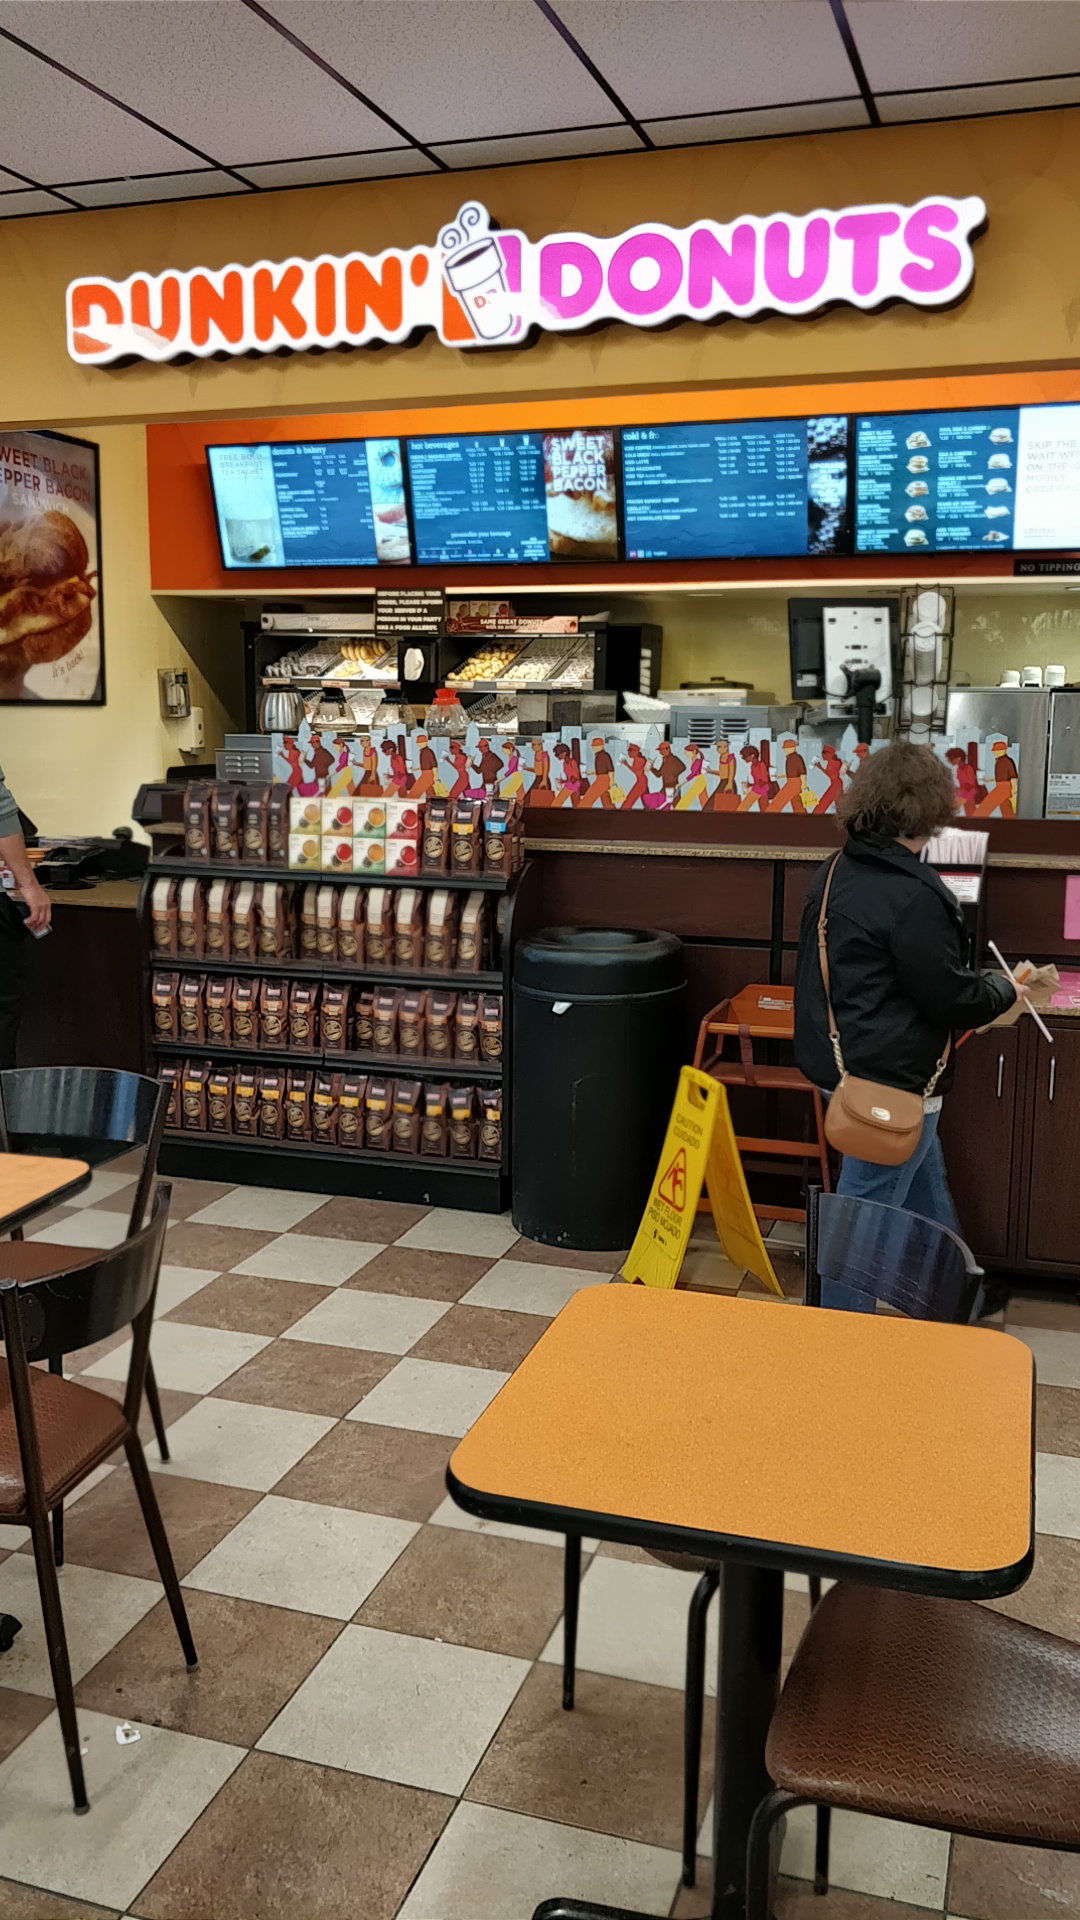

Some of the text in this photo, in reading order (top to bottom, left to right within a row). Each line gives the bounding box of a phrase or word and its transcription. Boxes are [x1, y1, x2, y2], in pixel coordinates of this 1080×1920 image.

[72, 203, 962, 354] DUNKIN' DONUTS
[550, 435, 605, 451] SWEET
[623, 431, 639, 441] cold
[641, 431, 647, 440] &
[272, 448, 295, 456] donuts
[303, 446, 327, 455] bakery
[411, 440, 459, 450] hot beverages
[1028, 440, 1077, 450] SKIP THE
[219, 453, 263, 462] FREE BOLD
[551, 450, 605, 466] BLACK
[1027, 452, 1056, 461] WAIT
[43, 456, 87, 480] BLACK
[220, 461, 263, 469] BREAKFAST
[551, 463, 606, 479] PEPPER
[553, 476, 608, 492] BACON
[1026, 473, 1065, 483] MOBILE
[46, 479, 91, 504] BACON
[12, 492, 70, 515] SANDWICH
[1020, 562, 1080, 572] NO TIPPING
[675, 1113, 704, 1137] CAUTION
[673, 1126, 700, 1150] CUIDADO
[653, 1197, 682, 1227] WET FLOOR
[648, 1207, 660, 1223] PISO
[660, 1216, 681, 1240] MOJADO
